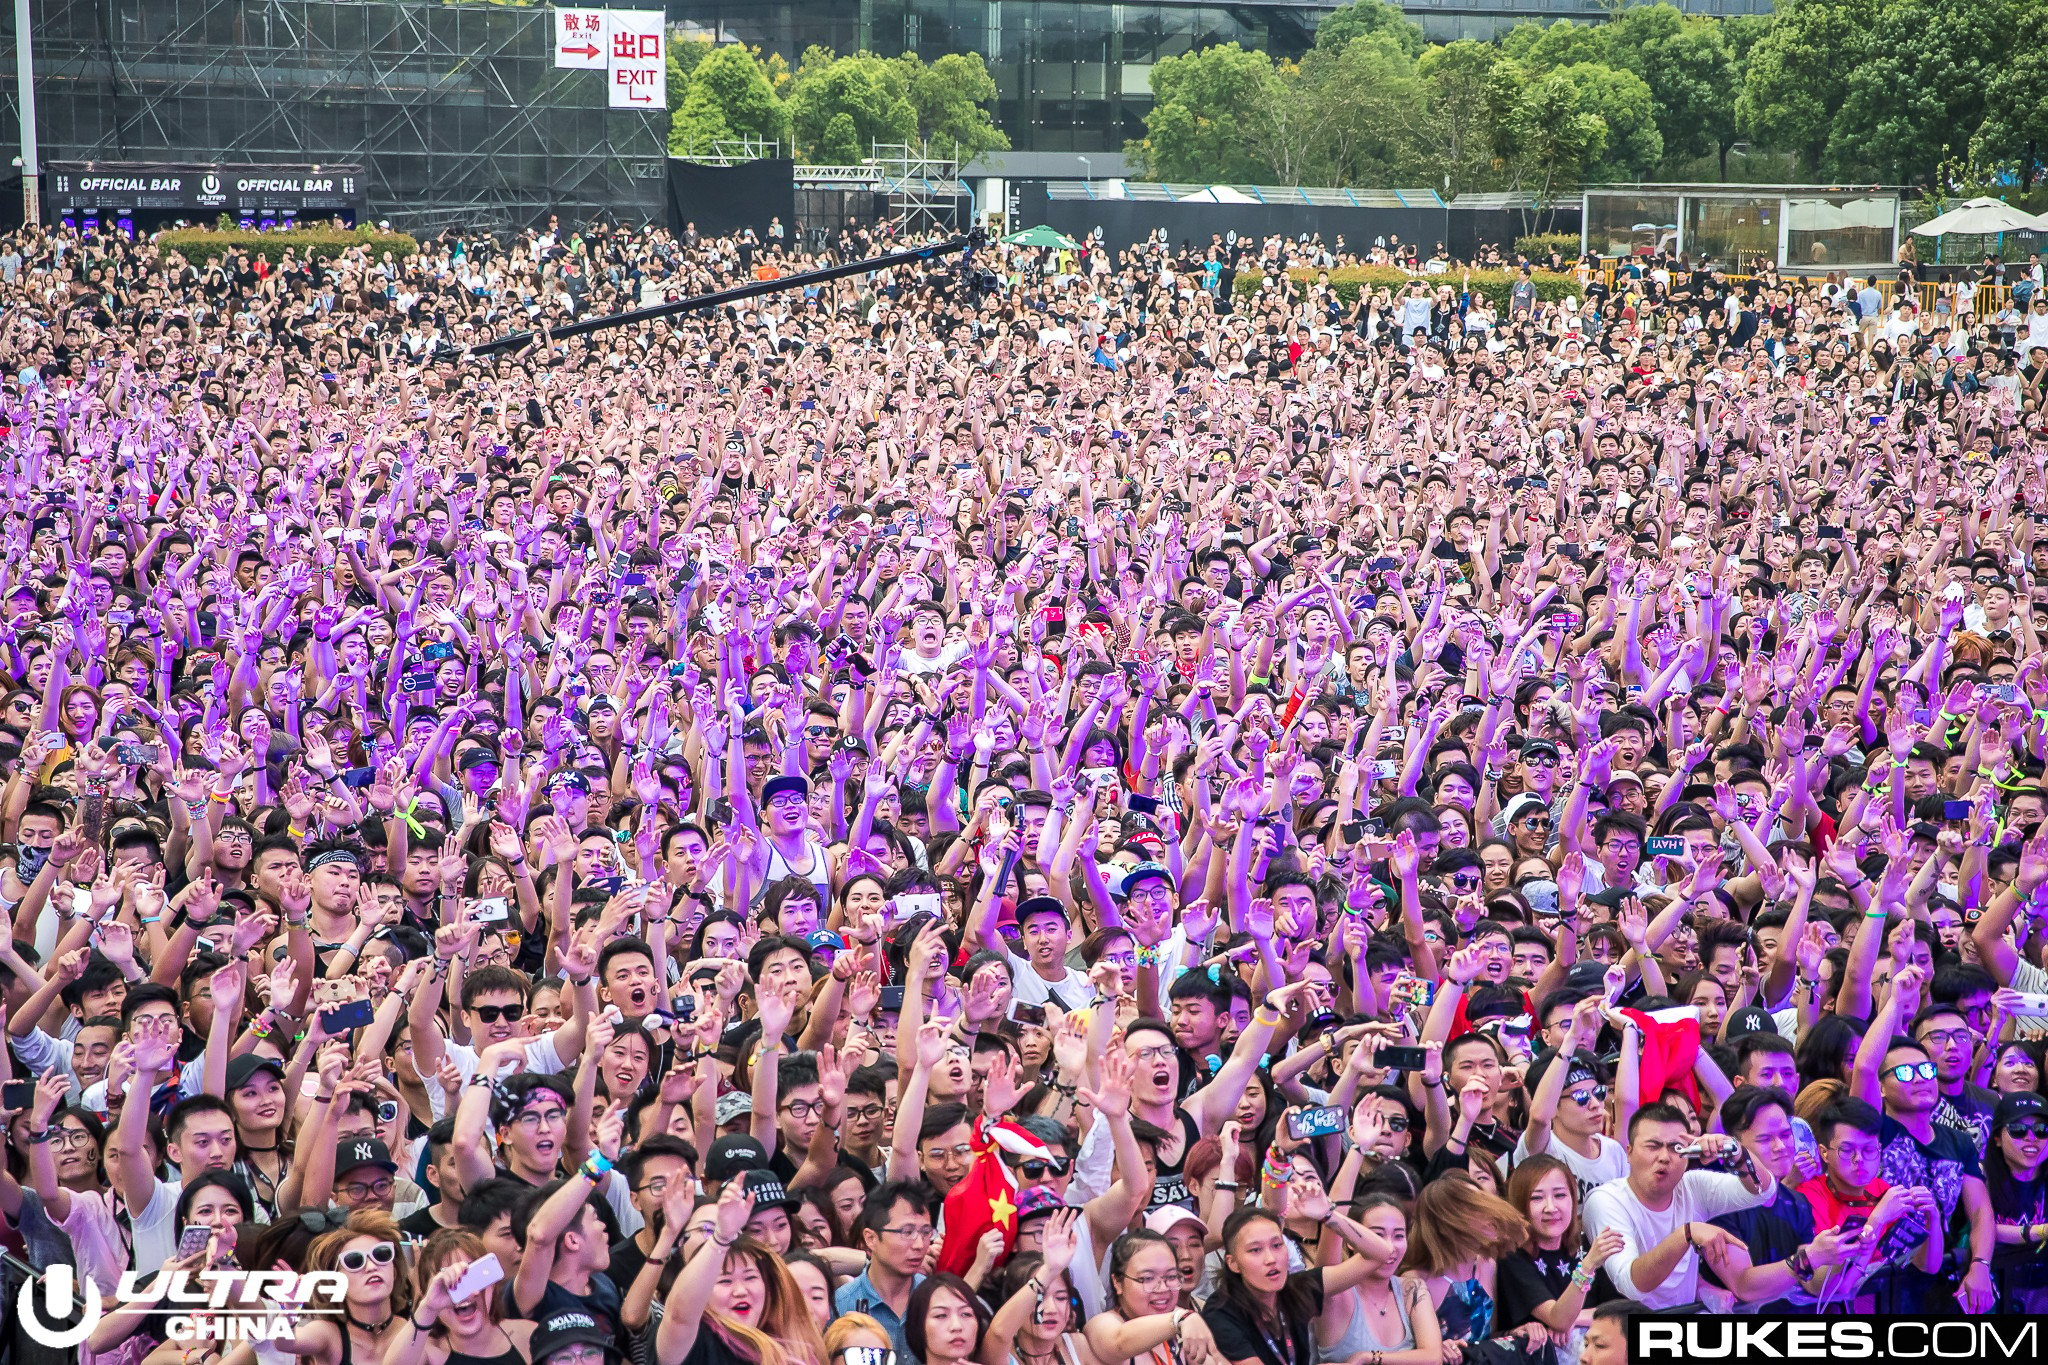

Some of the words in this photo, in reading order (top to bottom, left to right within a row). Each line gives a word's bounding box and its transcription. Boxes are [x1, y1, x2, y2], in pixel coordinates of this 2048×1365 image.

[564, 14, 600, 31] 散场
[614, 32, 659, 59] 出口
[617, 70, 657, 85] EXIT
[80, 177, 147, 191] OFFICIAL
[150, 178, 181, 191] BAR
[237, 179, 300, 192] OFFICIAL
[304, 180, 333, 192] BAR
[197, 194, 226, 202] ULTRA
[1652, 840, 1677, 849] HAY!
[1746, 1014, 1760, 1030] NY
[354, 1142, 373, 1160] NY
[1153, 1183, 1188, 1203] SAY
